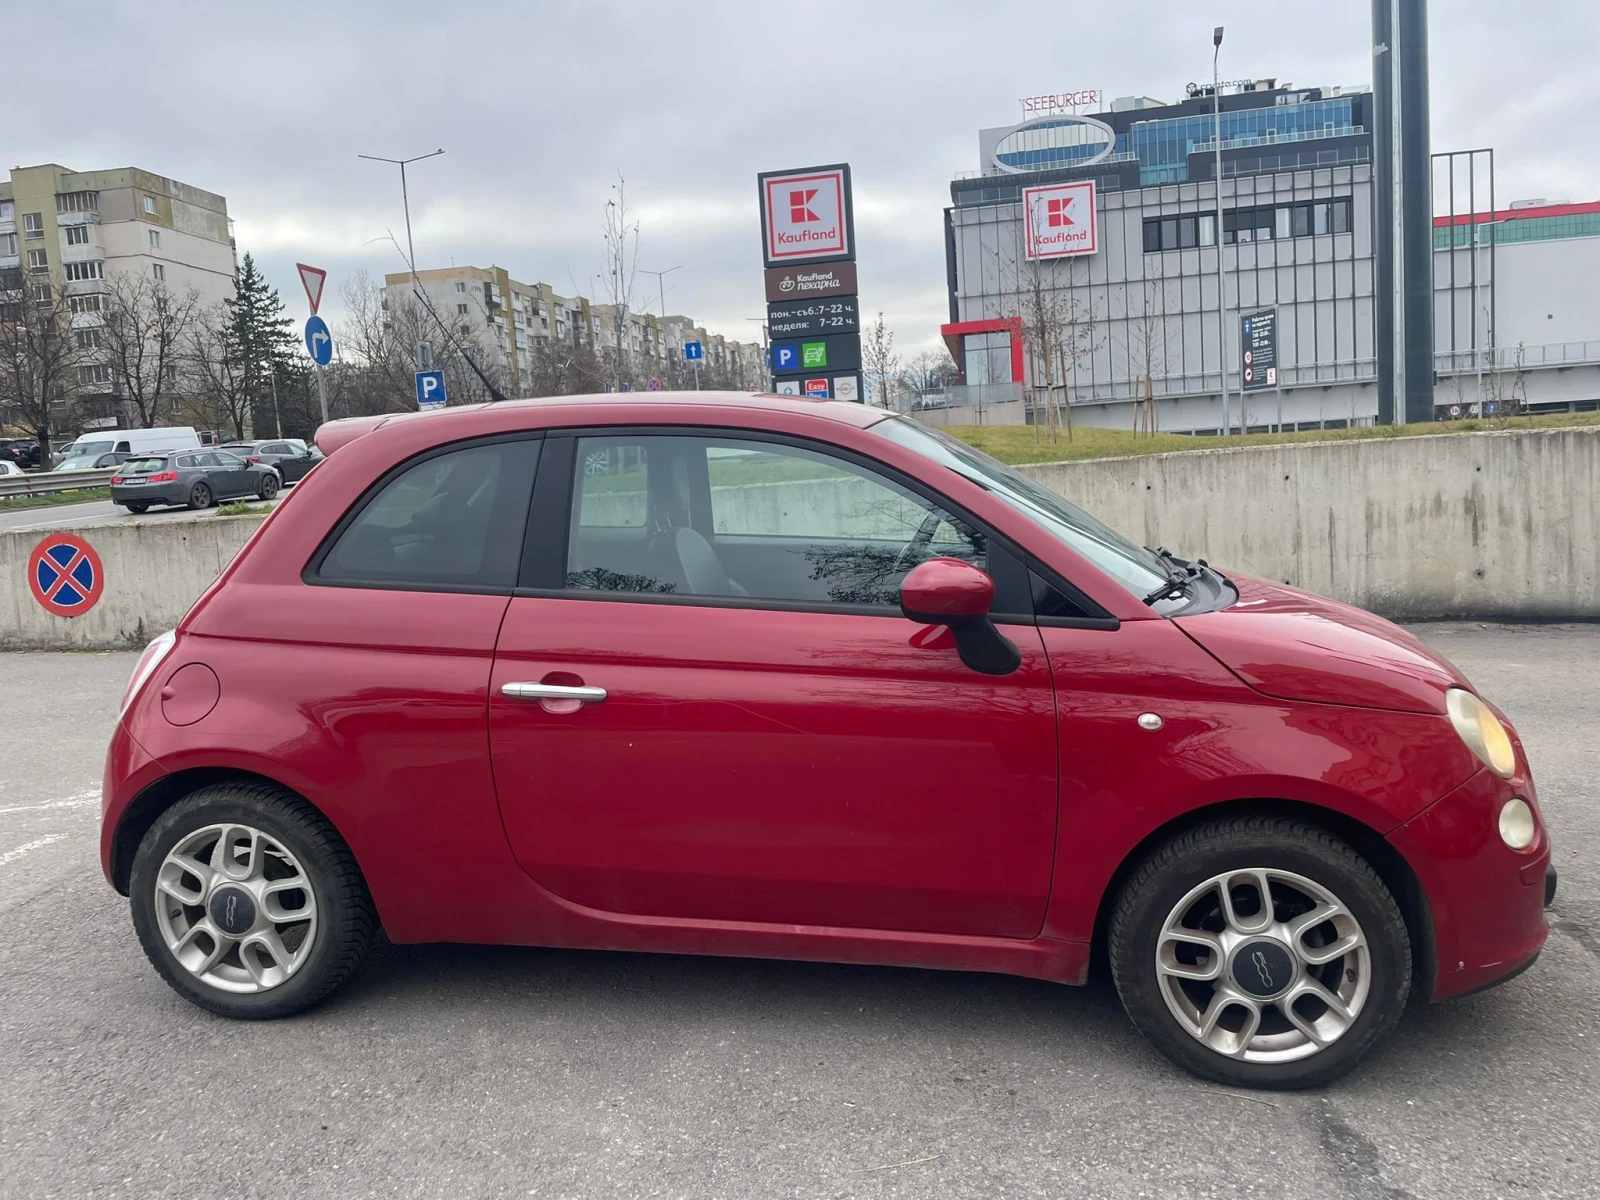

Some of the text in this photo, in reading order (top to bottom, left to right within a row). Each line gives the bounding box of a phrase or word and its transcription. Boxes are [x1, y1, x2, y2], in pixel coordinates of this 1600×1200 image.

[1025, 90, 1097, 111] SEEBURGER
[777, 227, 836, 244] Kaufland
[1035, 230, 1087, 245] Kaufland
[796, 272, 833, 282] Kaufland
[797, 279, 841, 290] пекарна
[771, 322, 810, 332] неделя:
[819, 317, 844, 327] 7-22
[779, 349, 792, 366] P
[422, 376, 438, 399] P
[808, 383, 826, 391] Easy
